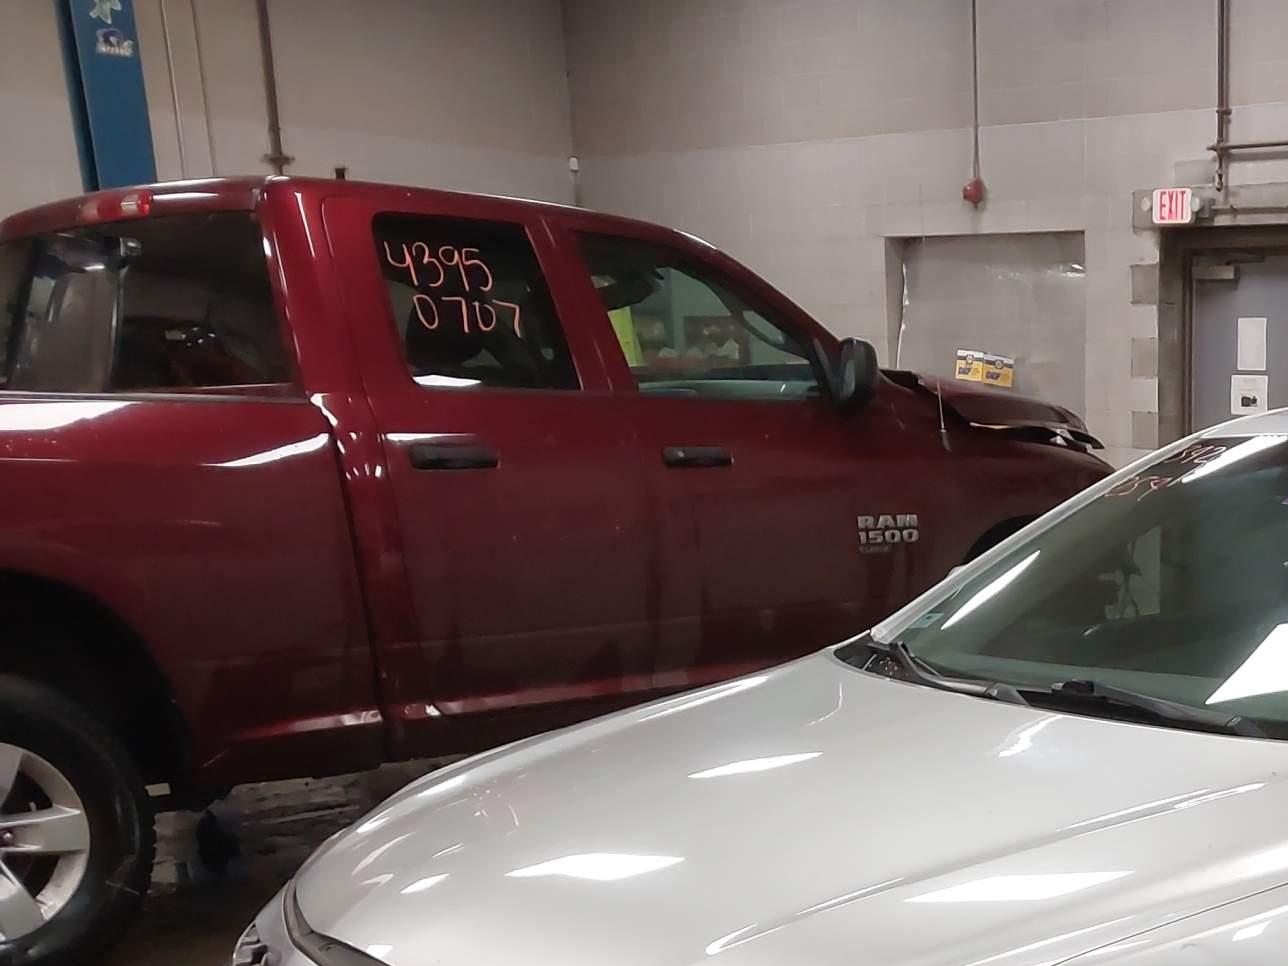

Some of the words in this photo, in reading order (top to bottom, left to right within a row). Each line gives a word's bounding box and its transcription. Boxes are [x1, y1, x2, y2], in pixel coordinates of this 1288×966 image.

[1160, 191, 1186, 220] EXIT
[384, 241, 493, 291] 4395
[413, 294, 521, 338] 0707
[857, 514, 918, 529] RAM
[859, 529, 919, 544] 1500
